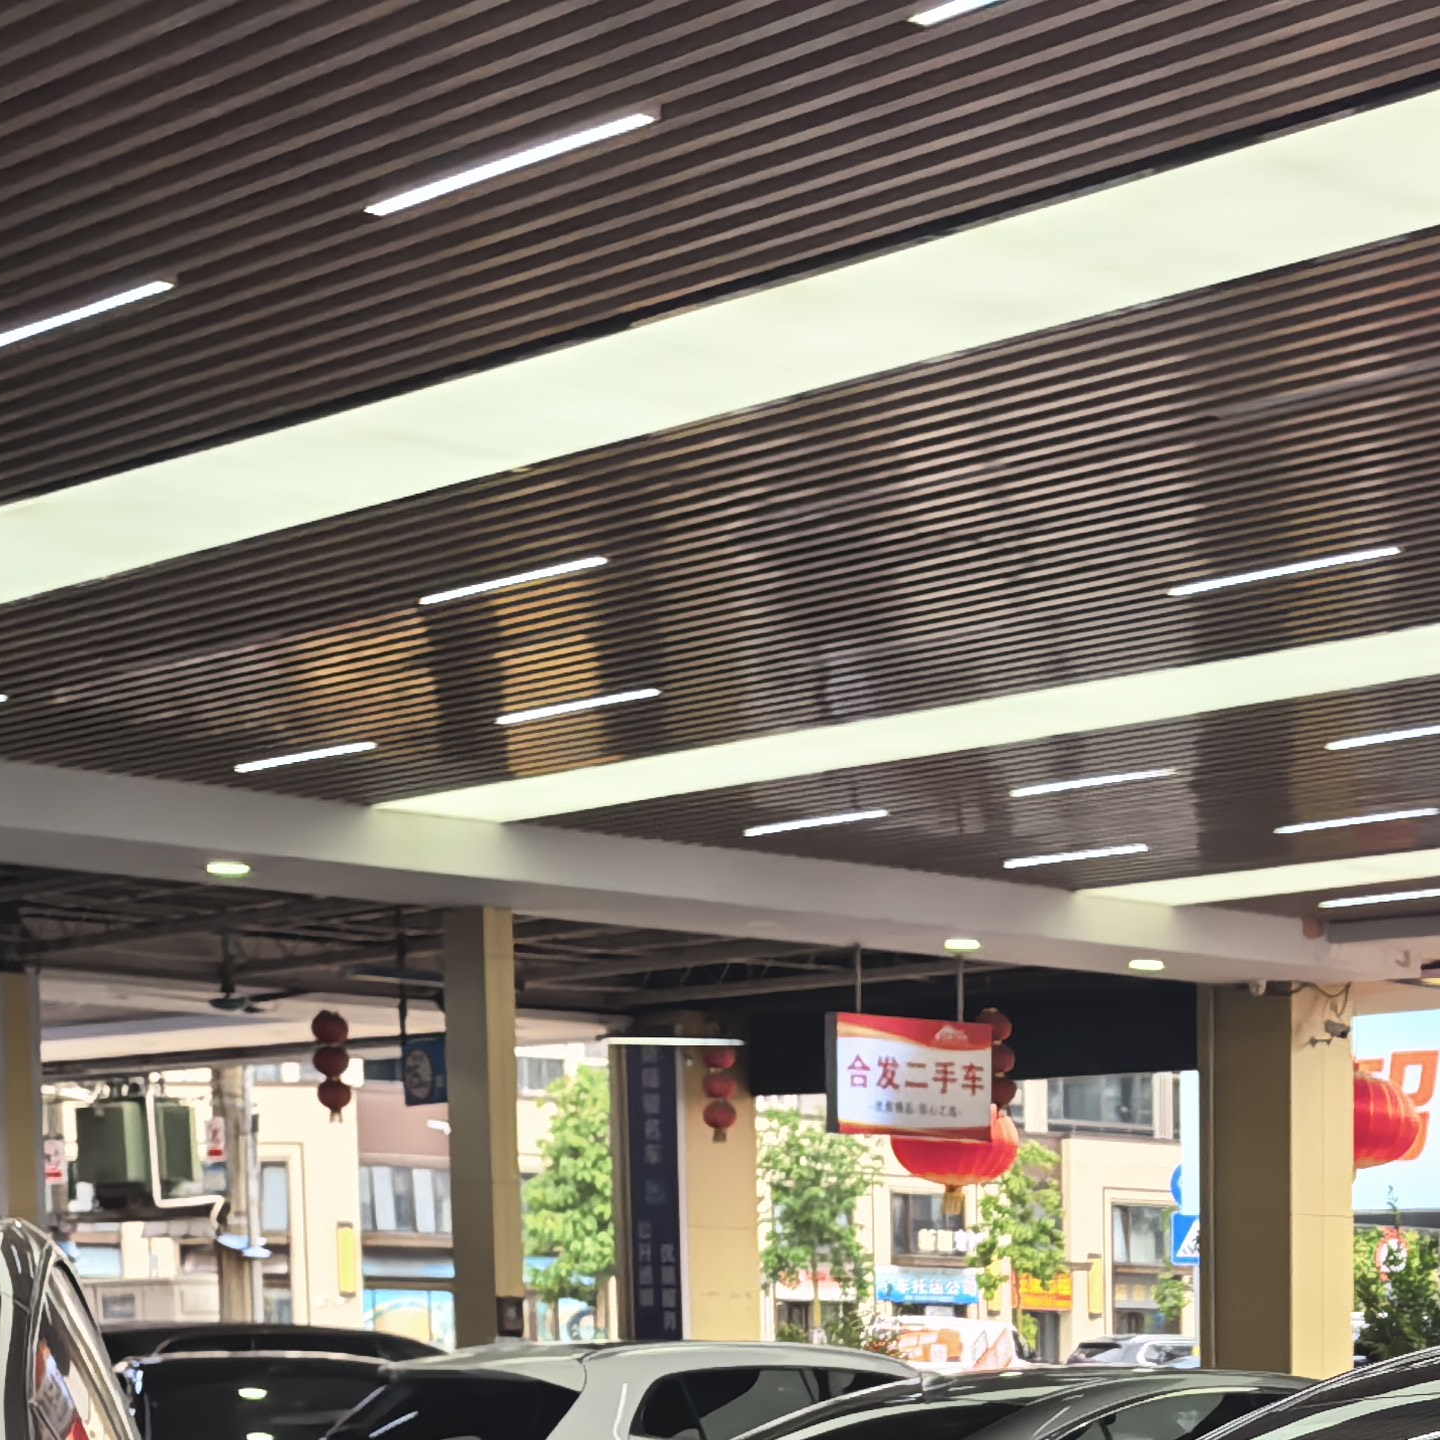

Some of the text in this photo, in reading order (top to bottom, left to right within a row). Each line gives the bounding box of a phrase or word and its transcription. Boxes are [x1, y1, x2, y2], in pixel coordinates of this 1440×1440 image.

[848, 1055, 984, 1096] 合发二手车
